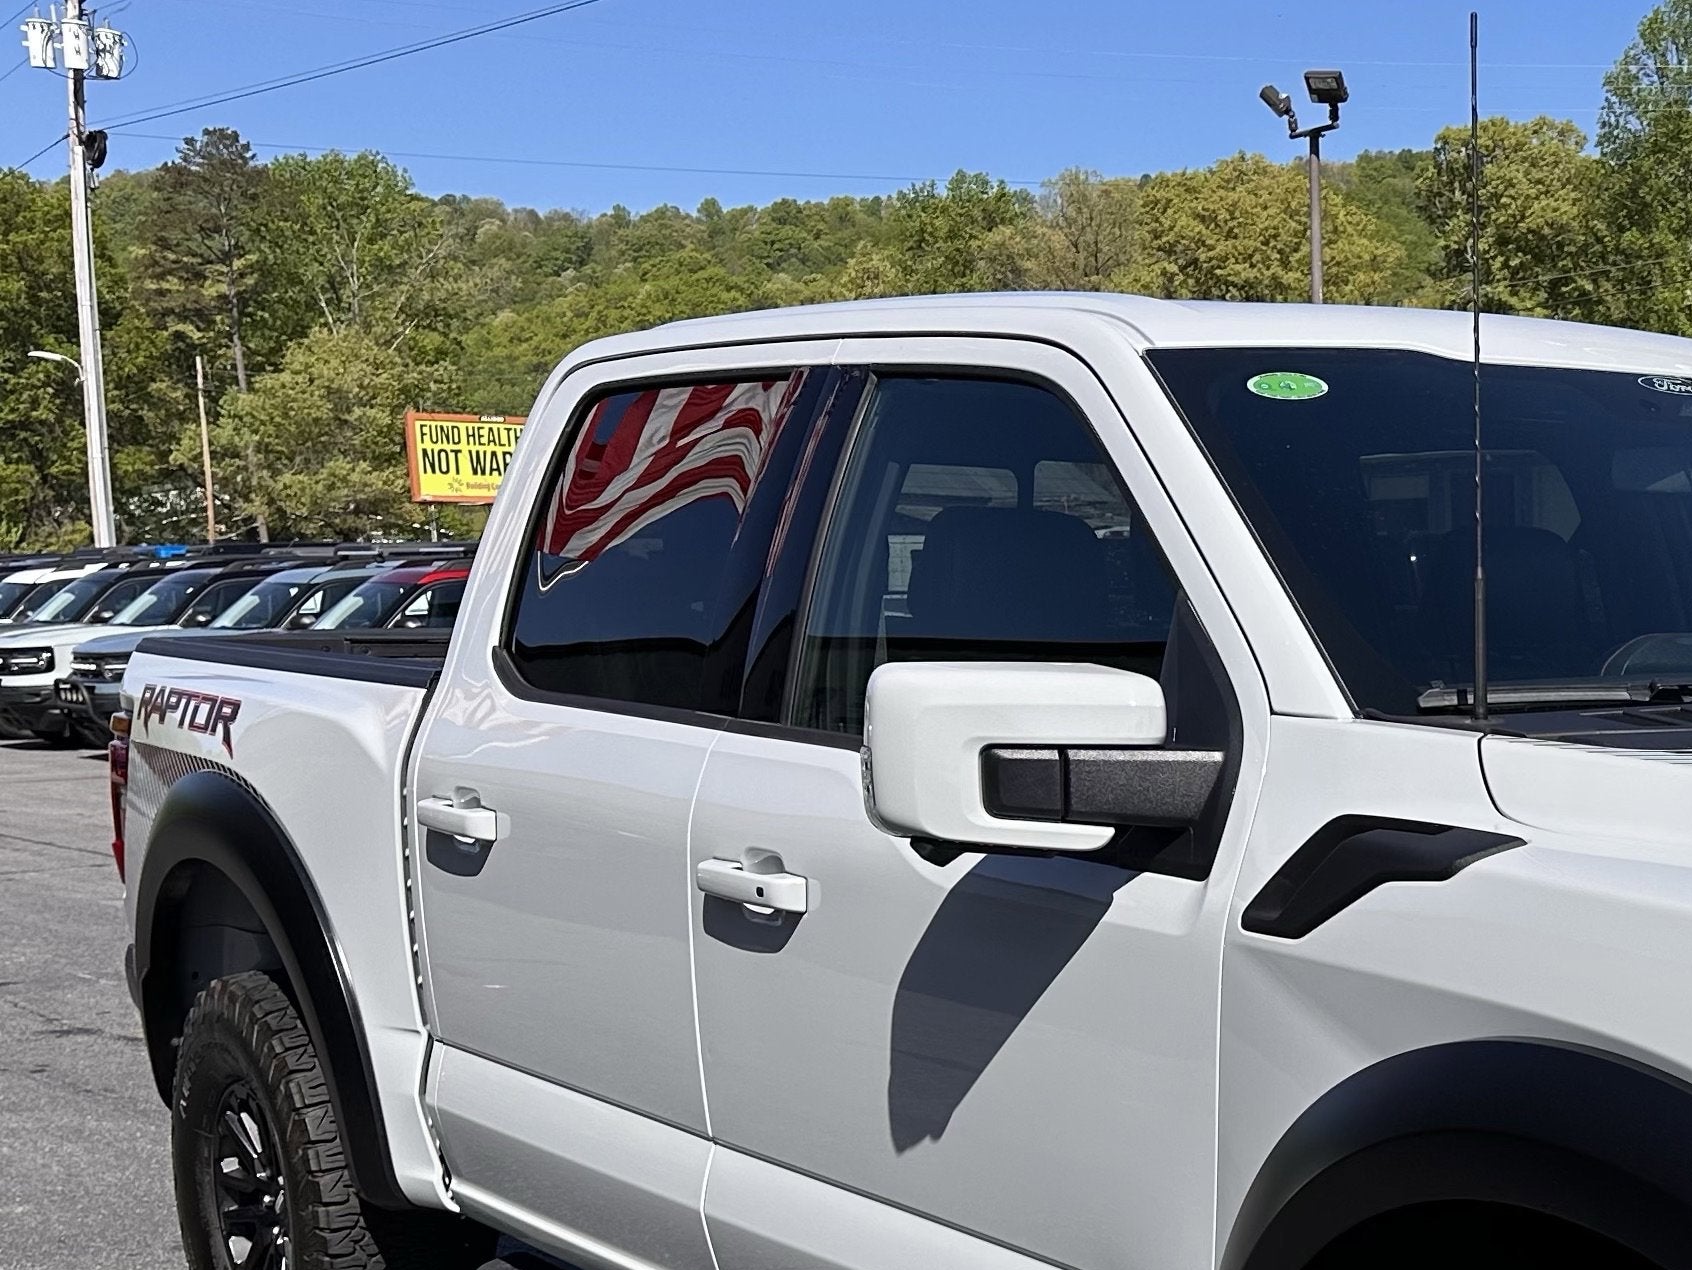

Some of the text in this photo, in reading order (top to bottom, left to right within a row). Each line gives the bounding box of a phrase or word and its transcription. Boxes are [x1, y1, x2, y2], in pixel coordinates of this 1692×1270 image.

[420, 424, 461, 446] FUND
[422, 448, 462, 475] NOT
[137, 683, 242, 761] RAPTOR
